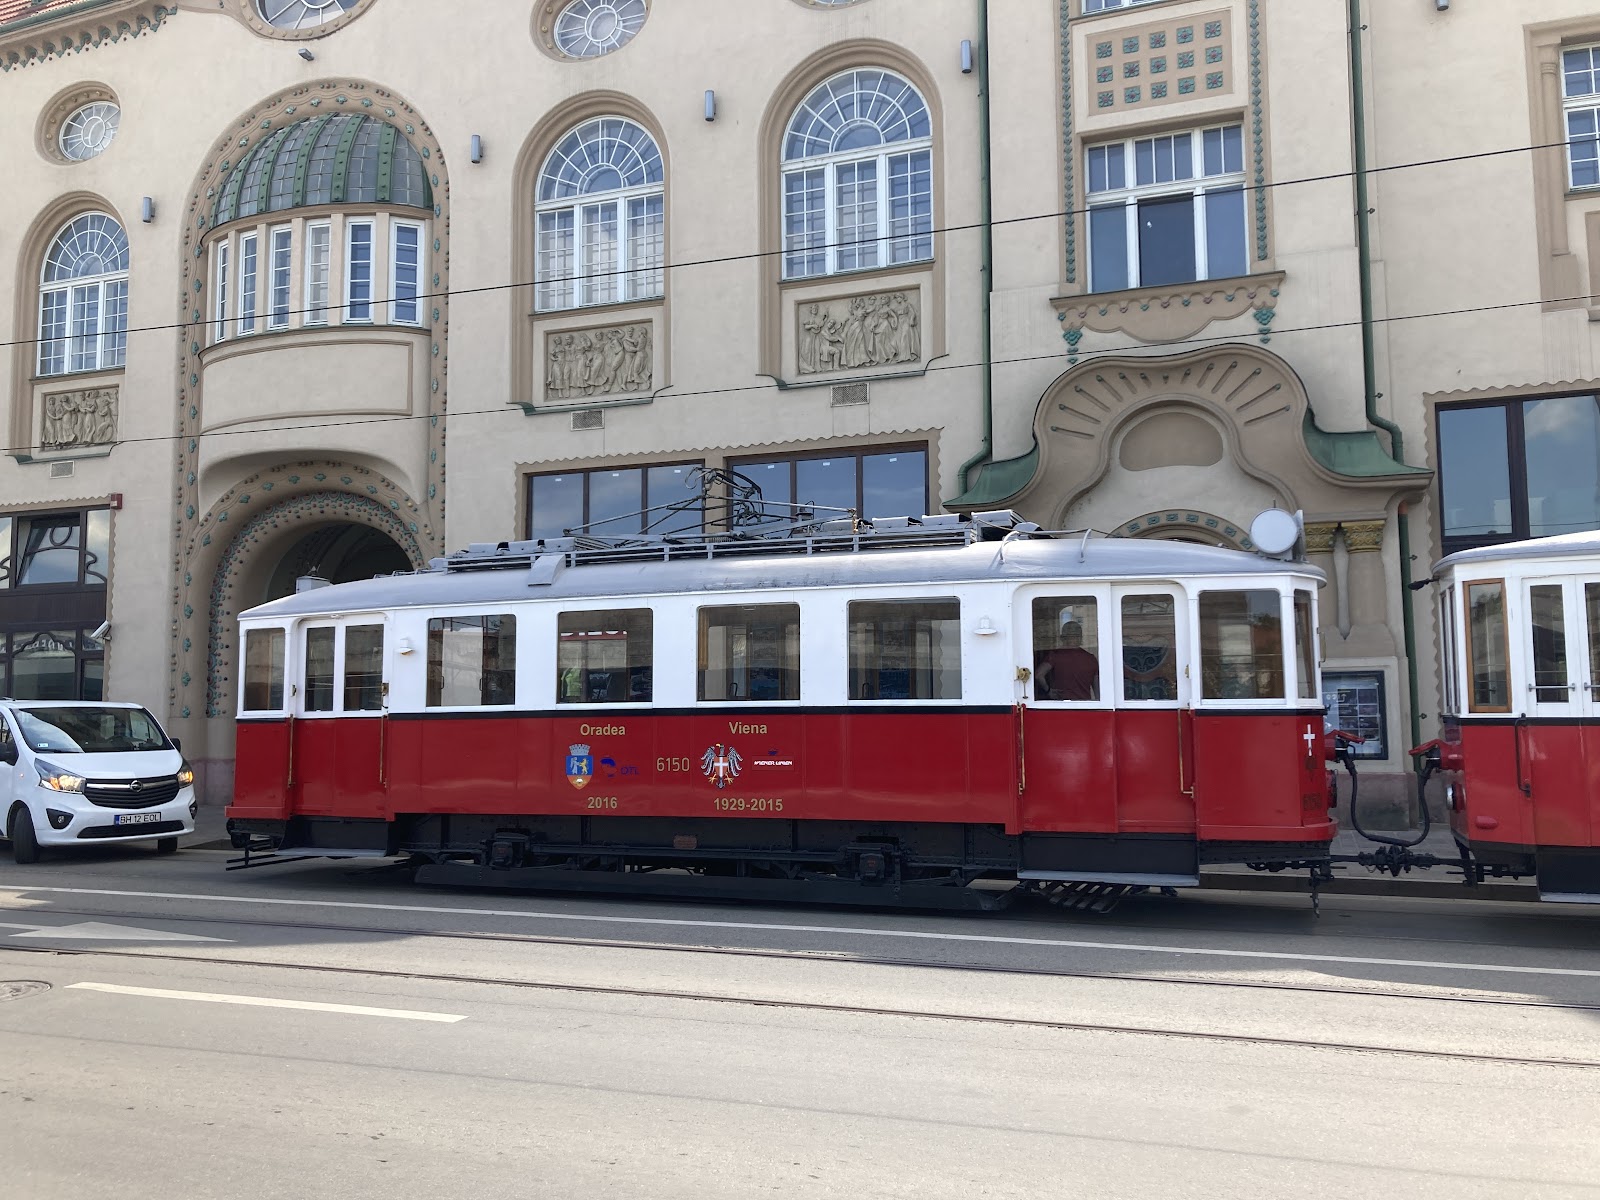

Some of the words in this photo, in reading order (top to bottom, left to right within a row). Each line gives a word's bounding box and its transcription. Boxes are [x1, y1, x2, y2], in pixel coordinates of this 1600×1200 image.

[580, 723, 626, 736] Oradea
[728, 721, 768, 734] Viena
[656, 757, 690, 771] 6150
[587, 797, 618, 809] 2016
[714, 798, 783, 811] 1929-2015
[120, 815, 132, 824] BH
[134, 815, 142, 823] 12
